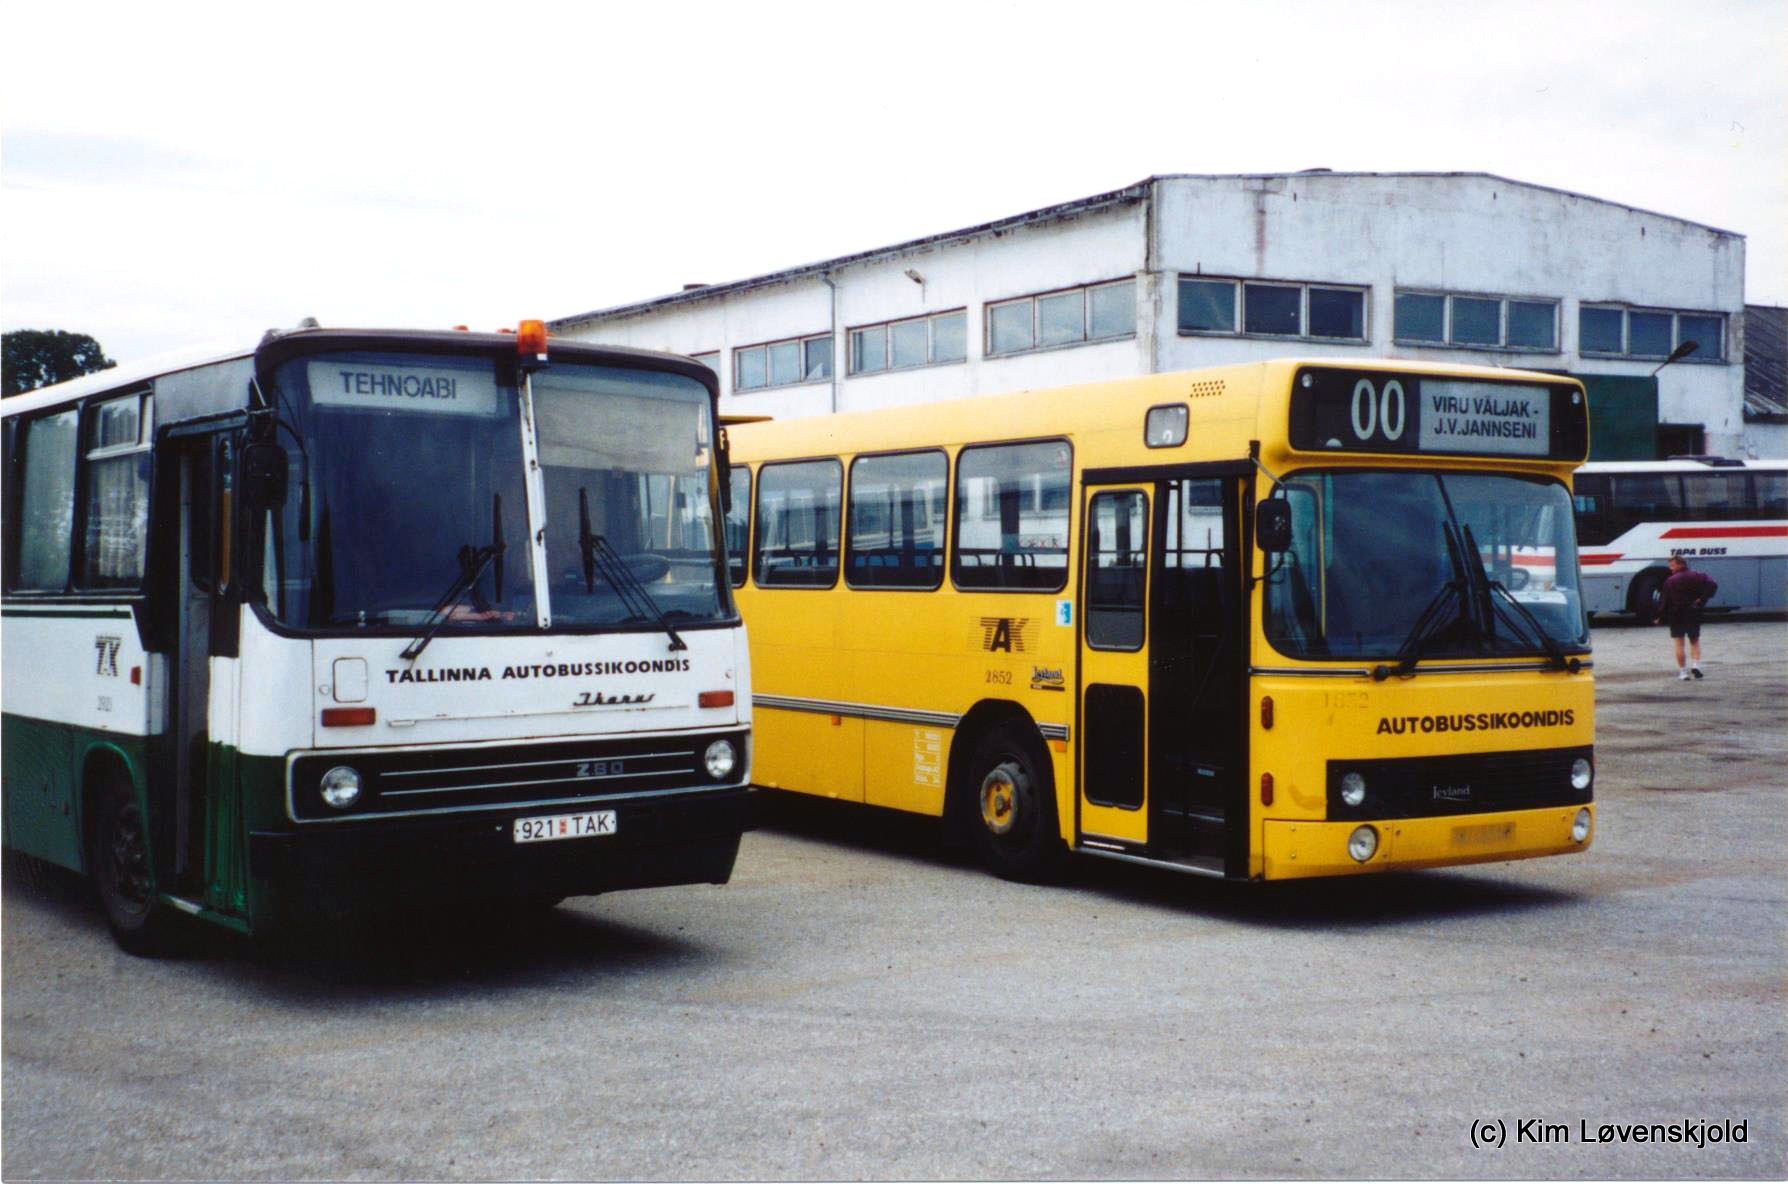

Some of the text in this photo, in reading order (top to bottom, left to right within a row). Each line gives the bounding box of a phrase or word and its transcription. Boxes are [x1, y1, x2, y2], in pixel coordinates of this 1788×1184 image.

[340, 371, 456, 399] TEHNOABI
[1351, 378, 1405, 441] 00
[1433, 396, 1469, 414] VIRU
[1473, 396, 1530, 418] VÄLJAK
[1434, 418, 1537, 439] J.V.JANNSENI
[385, 659, 690, 683] TALLINNA AUTOBUSSIKOONDIS
[1377, 709, 1575, 734] AUTOBUSSIKOONDIS
[522, 814, 609, 839] 921 TAK
